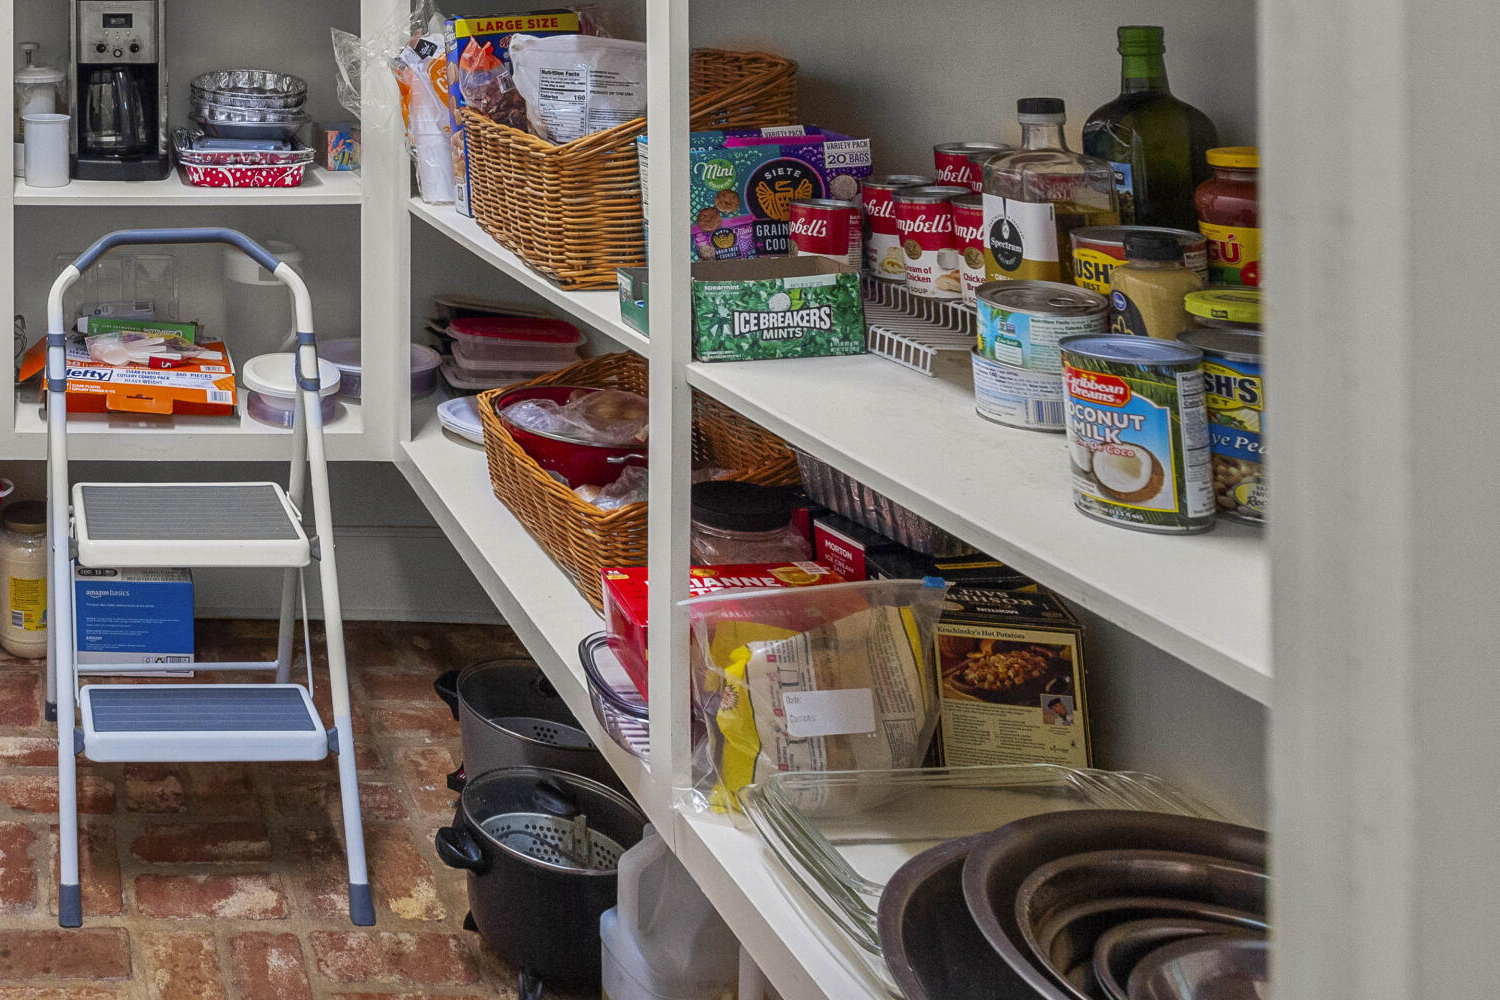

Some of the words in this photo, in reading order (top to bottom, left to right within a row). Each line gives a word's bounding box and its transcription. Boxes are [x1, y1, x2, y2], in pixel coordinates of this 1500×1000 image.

[476, 20, 525, 32] LARGE
[527, 18, 559, 29] SIZE
[541, 69, 564, 77] Nutrition
[826, 142, 851, 150] VARIETY
[851, 140, 868, 148] PACK
[827, 153, 847, 165] 20
[849, 152, 870, 163] BAGS
[694, 162, 734, 181] Mini
[764, 167, 802, 180] SIETE
[756, 224, 789, 237] GRAIN
[990, 237, 1022, 253] Spectrum
[923, 266, 932, 274] of
[910, 287, 929, 295] SOUP
[1082, 282, 1101, 291] BEST
[733, 311, 758, 336] ICE
[759, 306, 832, 330] BREAKERS
[762, 328, 803, 340] MINTS
[1065, 372, 1125, 395] Caribbean
[1071, 383, 1116, 403] Dreams
[1072, 419, 1122, 445] MILK
[1106, 444, 1135, 457] Coco
[825, 540, 853, 560] MORTON
[825, 554, 834, 563] ICE
[834, 559, 854, 573] CREAM
[833, 565, 846, 576] SALT
[85, 589, 109, 598] amazon
[109, 589, 130, 597] basics
[937, 625, 980, 637] Kruchinsky's
[996, 631, 1026, 640] Potatoes
